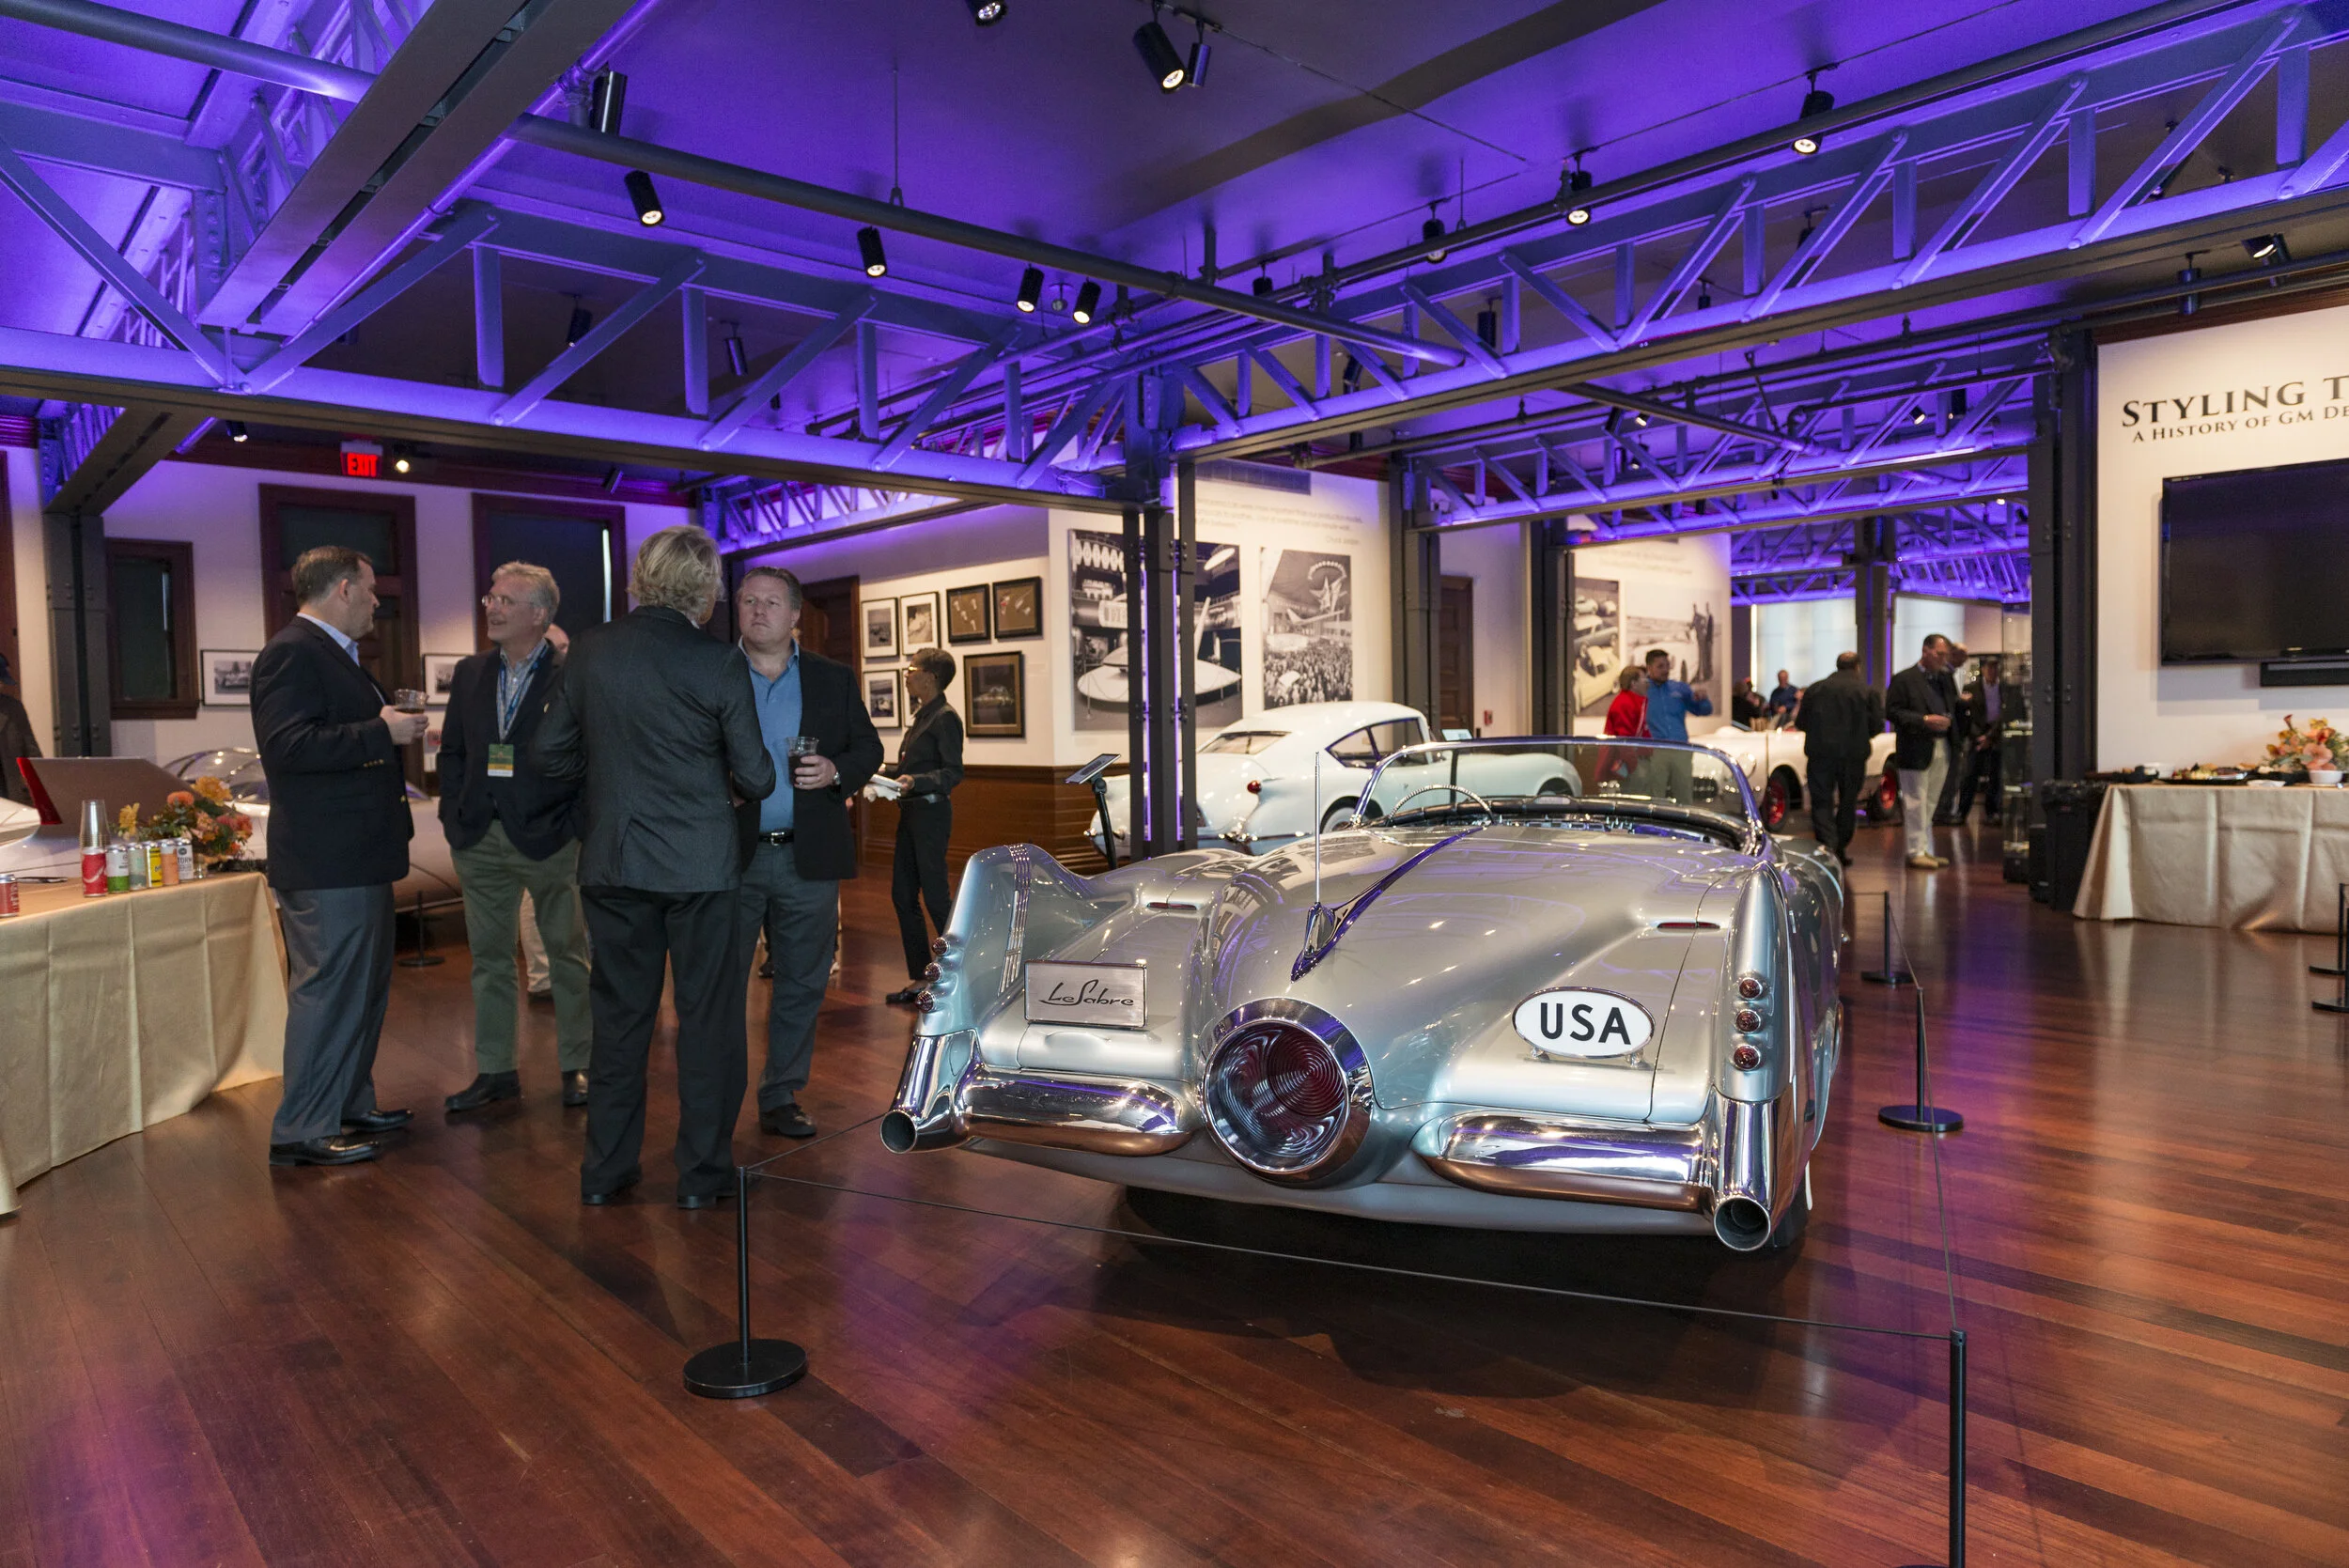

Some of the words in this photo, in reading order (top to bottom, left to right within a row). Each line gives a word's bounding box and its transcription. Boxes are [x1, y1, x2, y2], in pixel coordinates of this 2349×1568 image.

[2122, 380, 2307, 427] STYLING
[2133, 431, 2145, 443] A
[2153, 420, 2238, 441] HISTORY
[2246, 415, 2271, 429] OF
[2279, 410, 2314, 425] GM
[347, 452, 379, 478] EXIT
[1038, 979, 1134, 1006] LeSabre
[1540, 1002, 1632, 1046] USA
